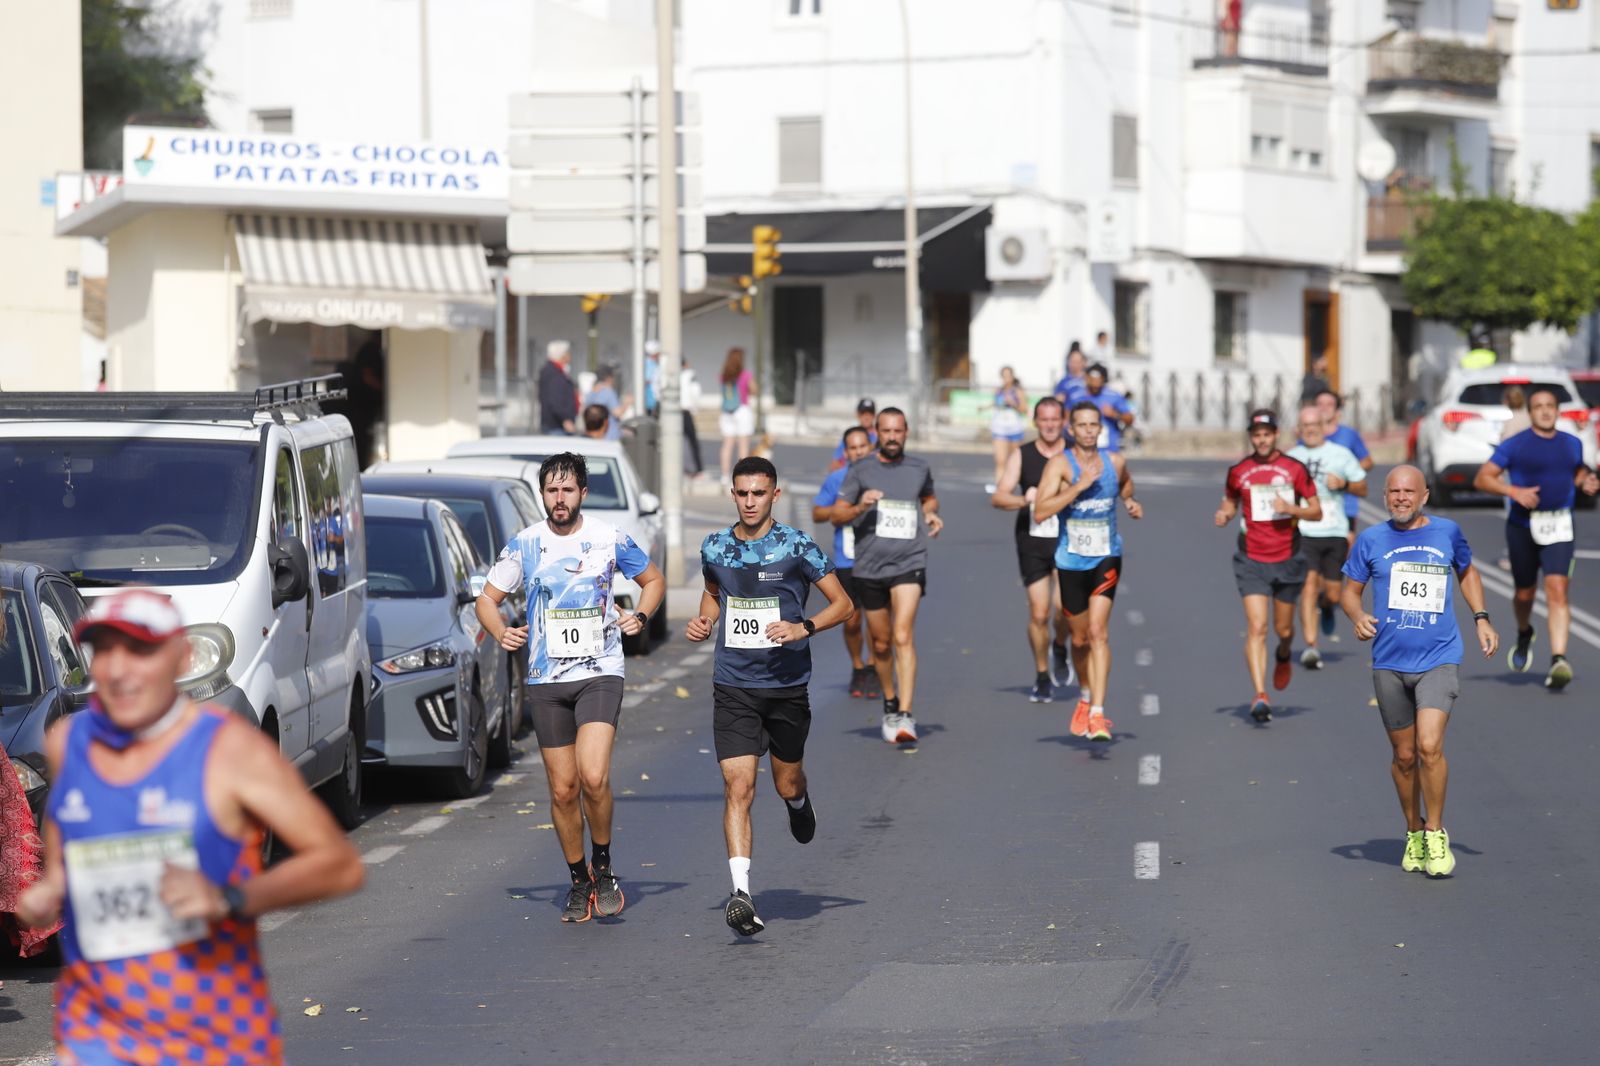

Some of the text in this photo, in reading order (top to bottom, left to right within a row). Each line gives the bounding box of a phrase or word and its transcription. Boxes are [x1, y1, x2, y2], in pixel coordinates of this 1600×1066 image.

[170, 136, 322, 160] CHURROS
[352, 144, 501, 167] CHOCOLA
[214, 163, 480, 191] PATATAS FRITAS
[316, 298, 404, 322] ONUTAPI
[885, 515, 906, 528] 200
[1077, 534, 1092, 546] 60
[1400, 581, 1428, 598] 643
[734, 601, 750, 609] VUELTA
[755, 600, 775, 609] HUELVA
[556, 610, 575, 619] VUELTA
[576, 610, 580, 618] A
[580, 608, 599, 618] HUELVA
[733, 618, 760, 635] 209
[561, 627, 580, 645] 10
[93, 882, 152, 925] 362
